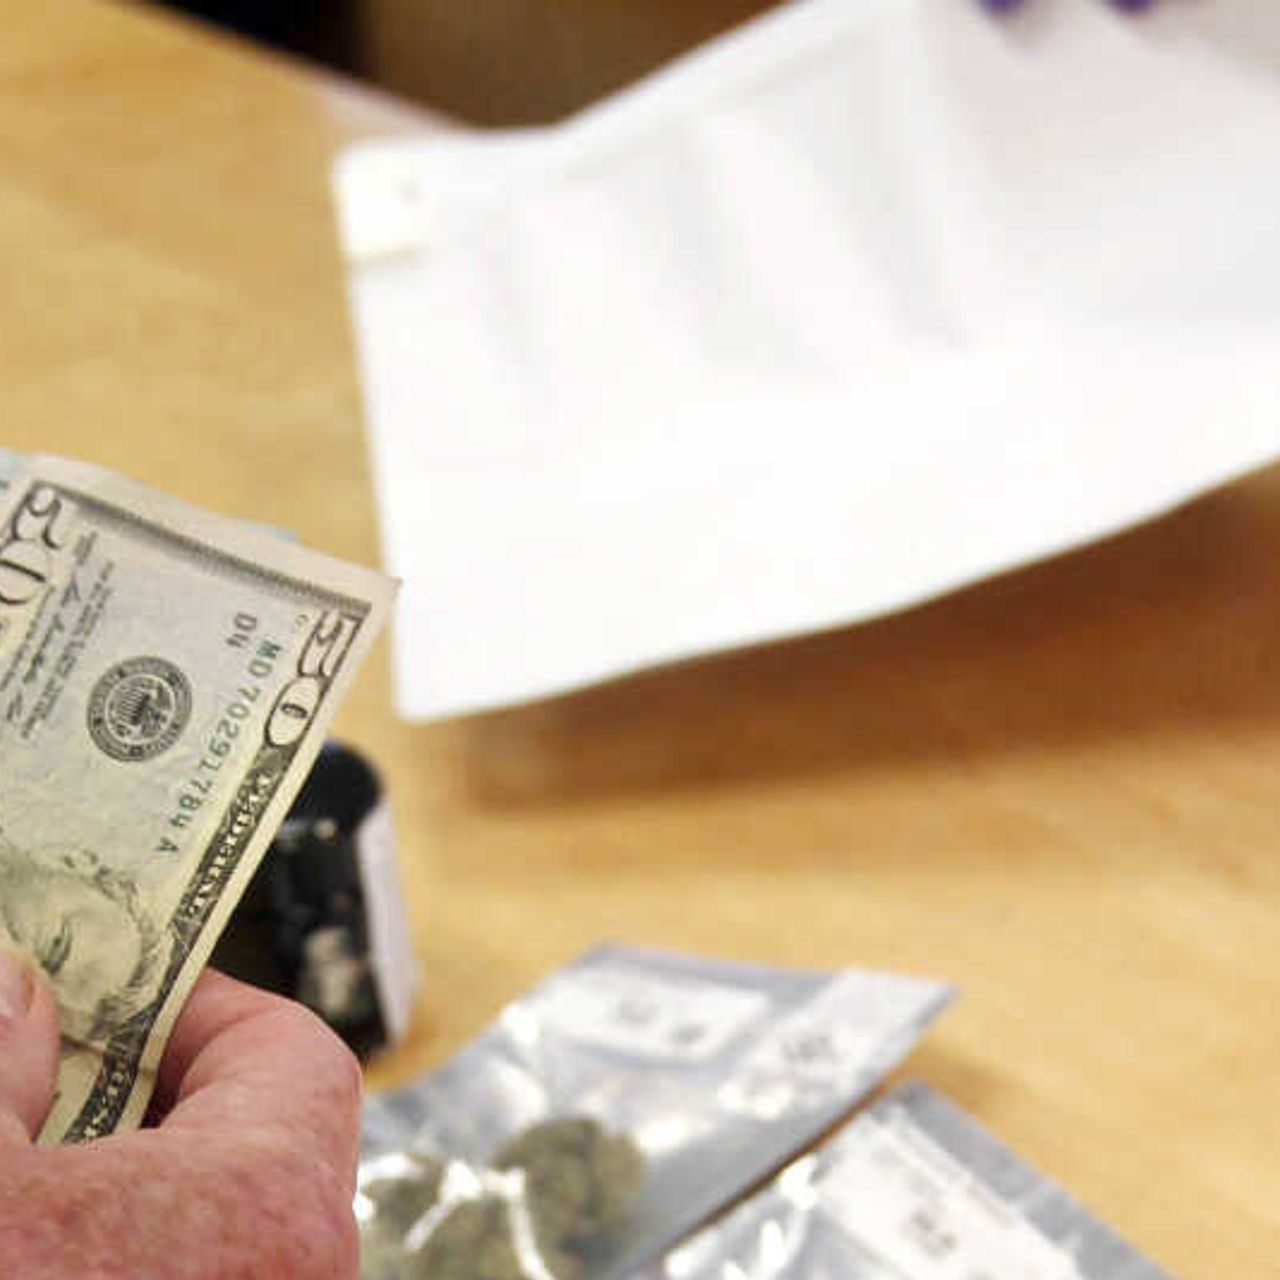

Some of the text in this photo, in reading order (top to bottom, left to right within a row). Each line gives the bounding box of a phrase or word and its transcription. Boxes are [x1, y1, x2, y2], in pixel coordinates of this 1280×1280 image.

[225, 612, 258, 648] D4
[265, 610, 364, 750] 50
[157, 639, 281, 855] MD 70291784 A
[187, 773, 271, 918] FEDERAL
